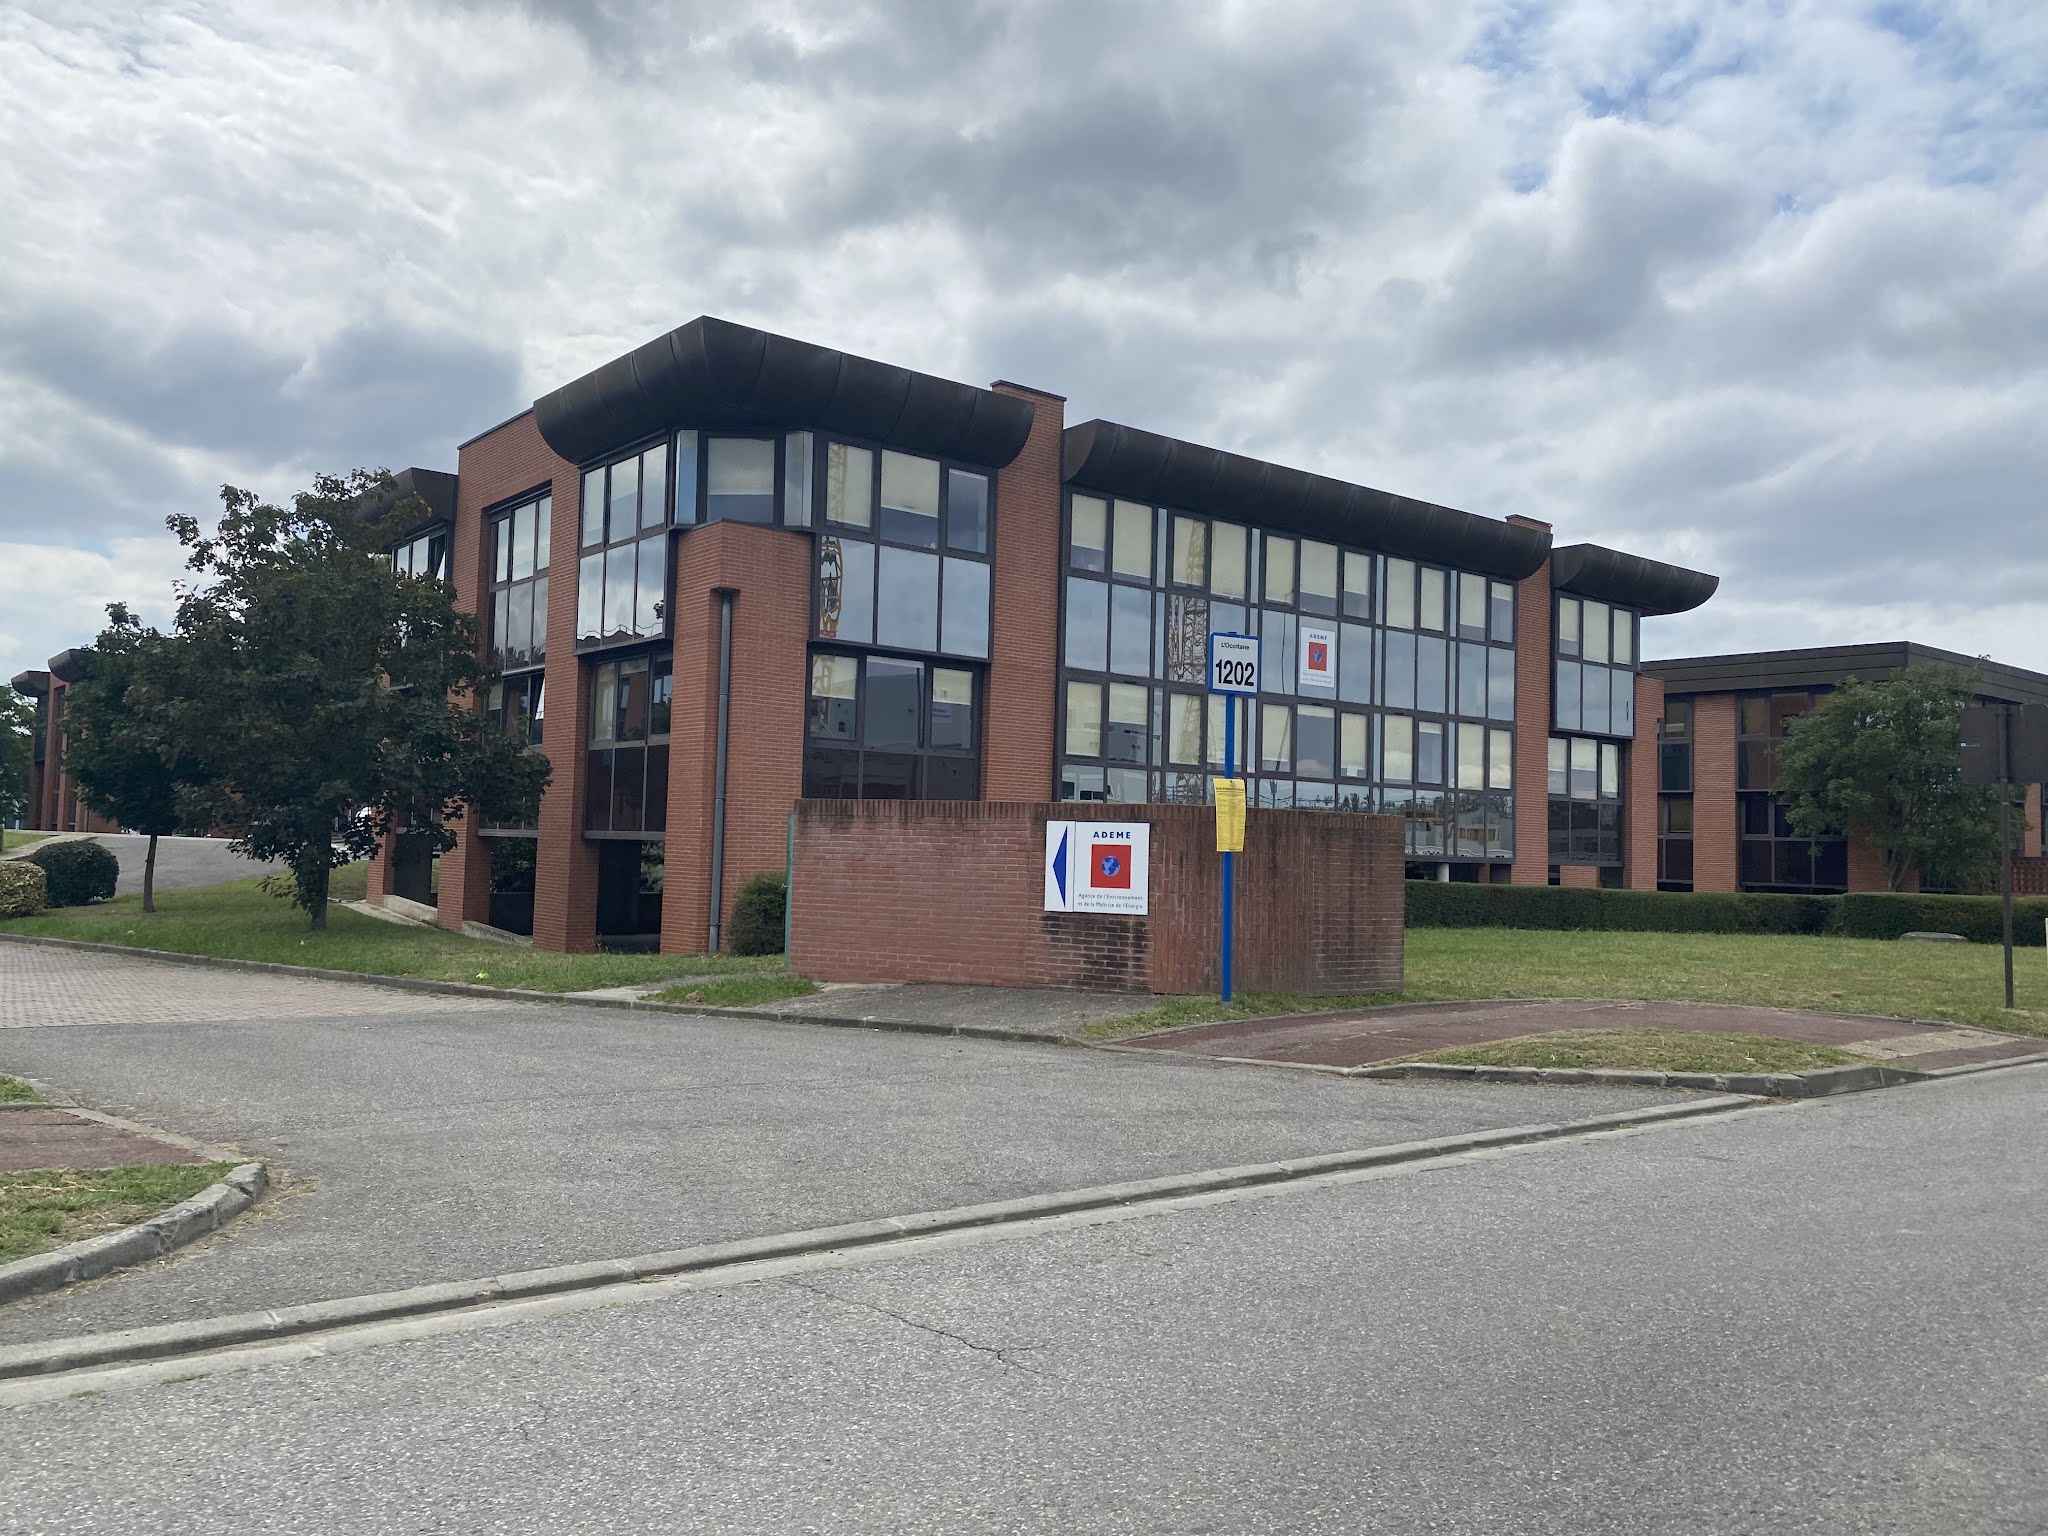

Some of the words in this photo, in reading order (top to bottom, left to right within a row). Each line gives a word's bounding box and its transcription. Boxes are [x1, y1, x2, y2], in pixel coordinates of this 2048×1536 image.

[1221, 642, 1249, 650] L'Occitane
[1215, 659, 1254, 686] 1202
[1093, 831, 1131, 839] ADEME
